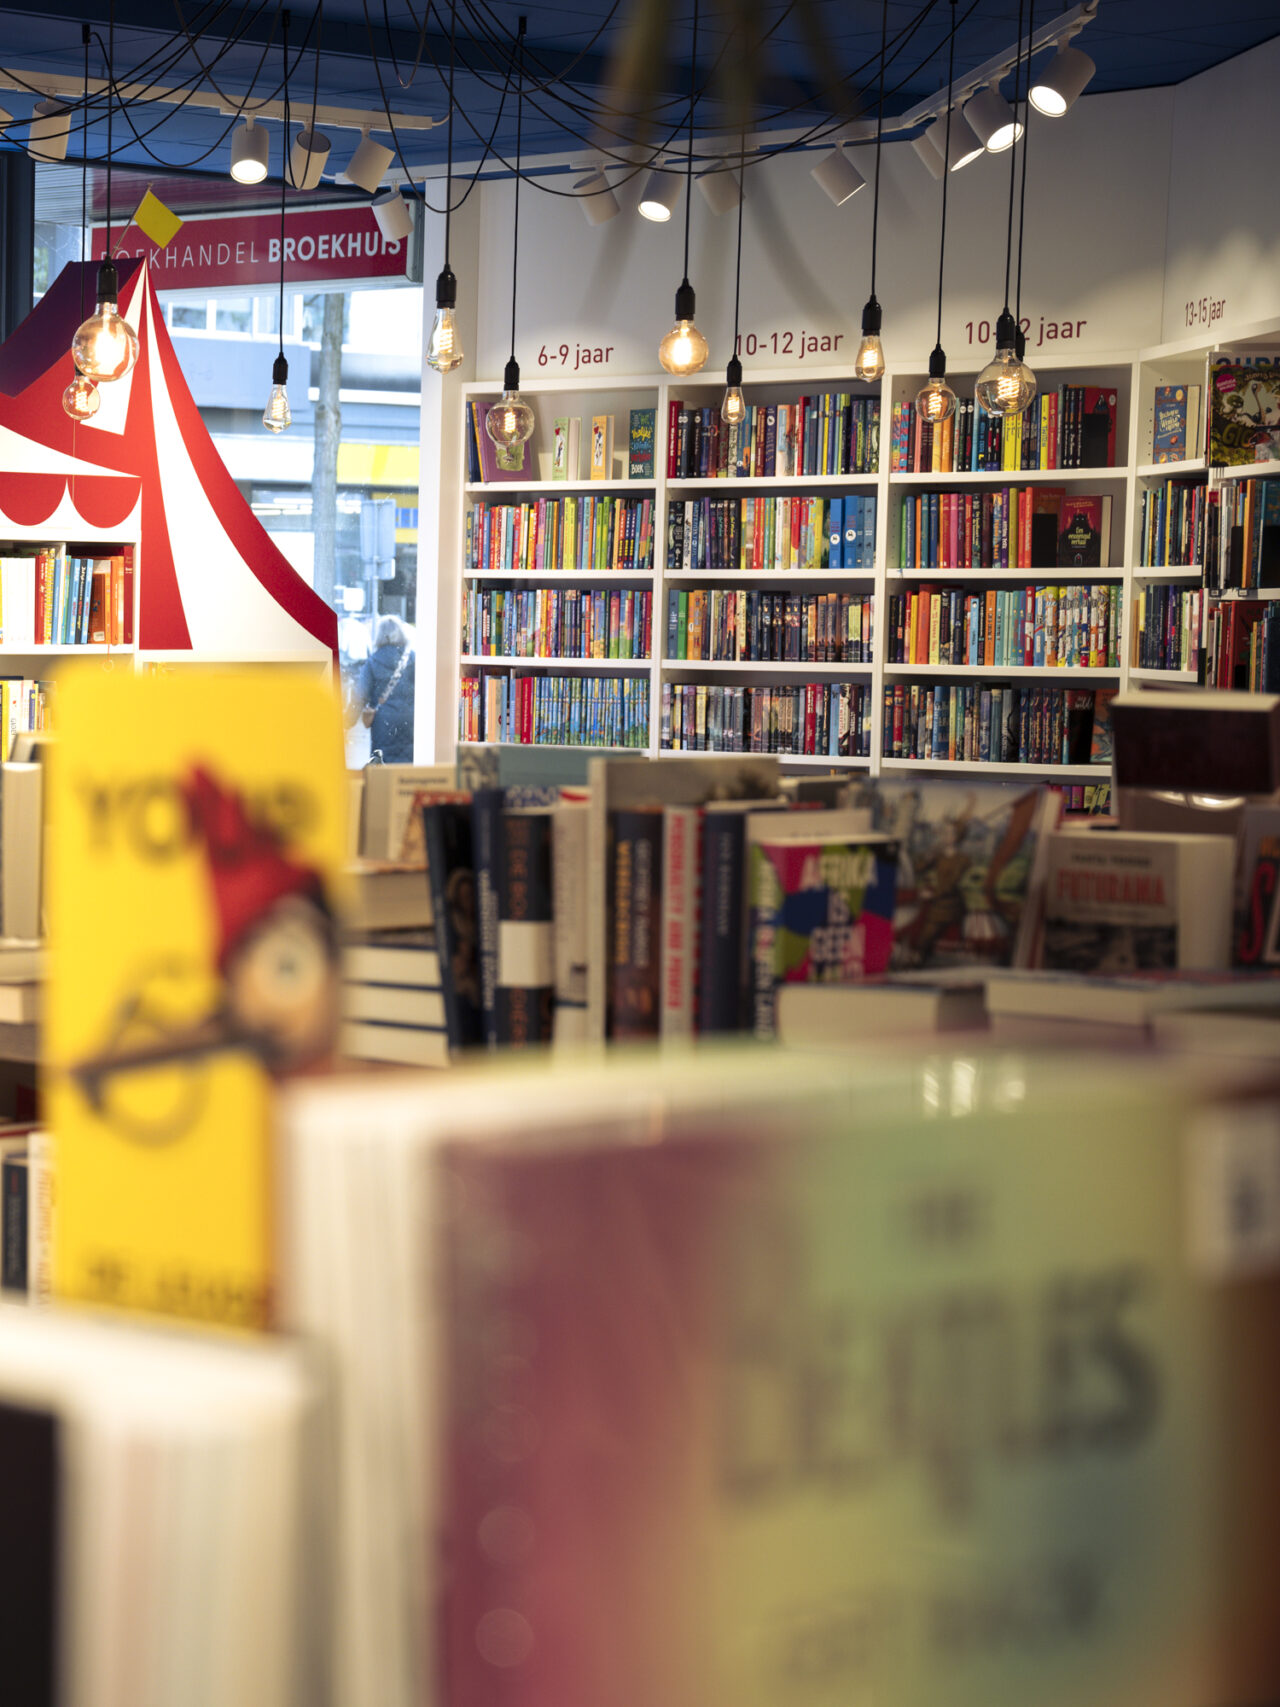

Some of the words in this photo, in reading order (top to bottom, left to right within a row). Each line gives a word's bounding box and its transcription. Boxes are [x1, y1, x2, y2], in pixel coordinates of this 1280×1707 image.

[268, 231, 401, 262] BROEKHUIS
[1184, 298, 1208, 327] 13-15
[1208, 296, 1226, 326] jaar
[734, 332, 794, 357] 10-12
[798, 330, 844, 359] jaar
[965, 317, 1031, 344] 10-2
[1036, 316, 1087, 346] jaar
[537, 344, 570, 367] 6-9
[573, 343, 614, 369] jaar
